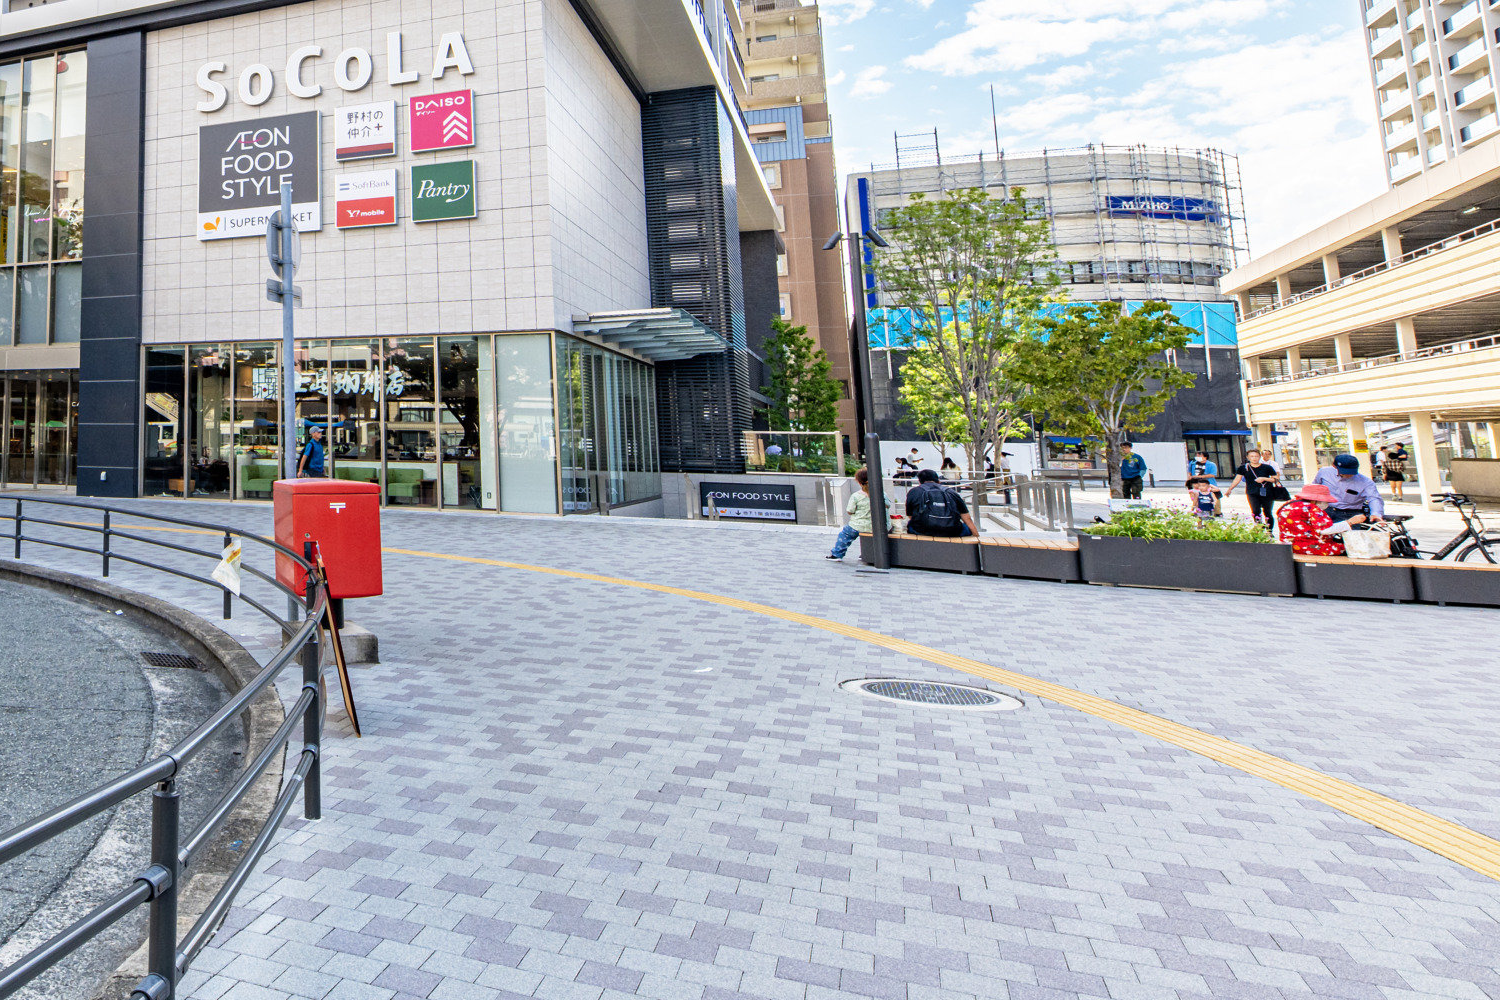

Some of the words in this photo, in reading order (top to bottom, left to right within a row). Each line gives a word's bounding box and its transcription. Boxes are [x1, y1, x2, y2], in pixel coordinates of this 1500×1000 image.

[196, 32, 475, 113] SoCoLA
[415, 96, 465, 111] DAISO
[347, 110, 384, 125] 野村の
[221, 150, 294, 176] FOOD
[221, 173, 294, 200] STYLE
[352, 180, 391, 190] SoftBank
[416, 179, 470, 203] Pantry
[1121, 200, 1170, 210] MZHO
[230, 211, 313, 229] SUPERKET
[732, 492, 760, 500] FOOD
[762, 493, 790, 501] STYLE
